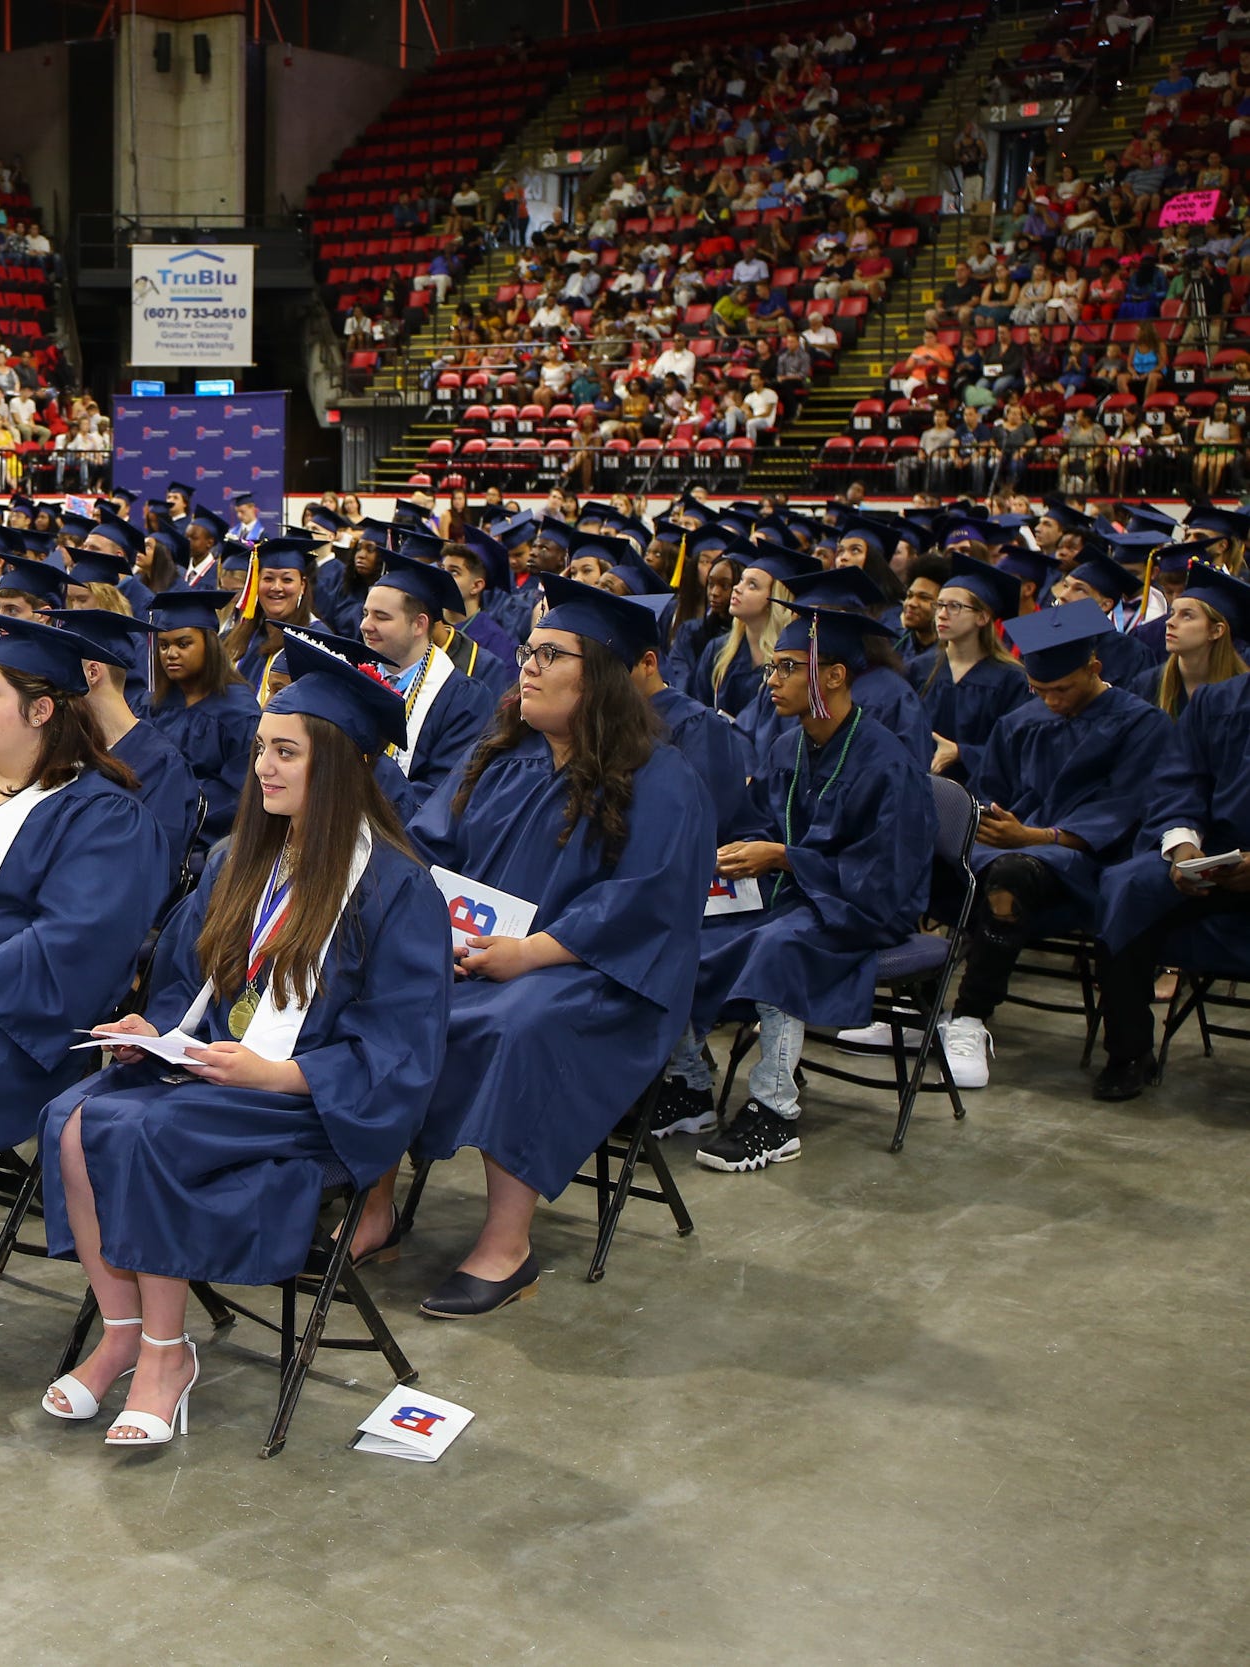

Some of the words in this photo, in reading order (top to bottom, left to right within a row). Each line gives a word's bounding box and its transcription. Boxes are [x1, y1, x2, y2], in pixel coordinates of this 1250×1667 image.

[990, 105, 1007, 122] 21
[157, 269, 238, 285] TruBlu
[143, 308, 179, 321] (607)
[183, 308, 247, 319] 733-0510
[194, 321, 233, 331] Cleaning
[160, 331, 189, 339] Gutter
[191, 331, 229, 341] Cleaning
[155, 341, 194, 349] Pressure
[197, 341, 235, 351] Washing
[390, 1406, 446, 1438] B
